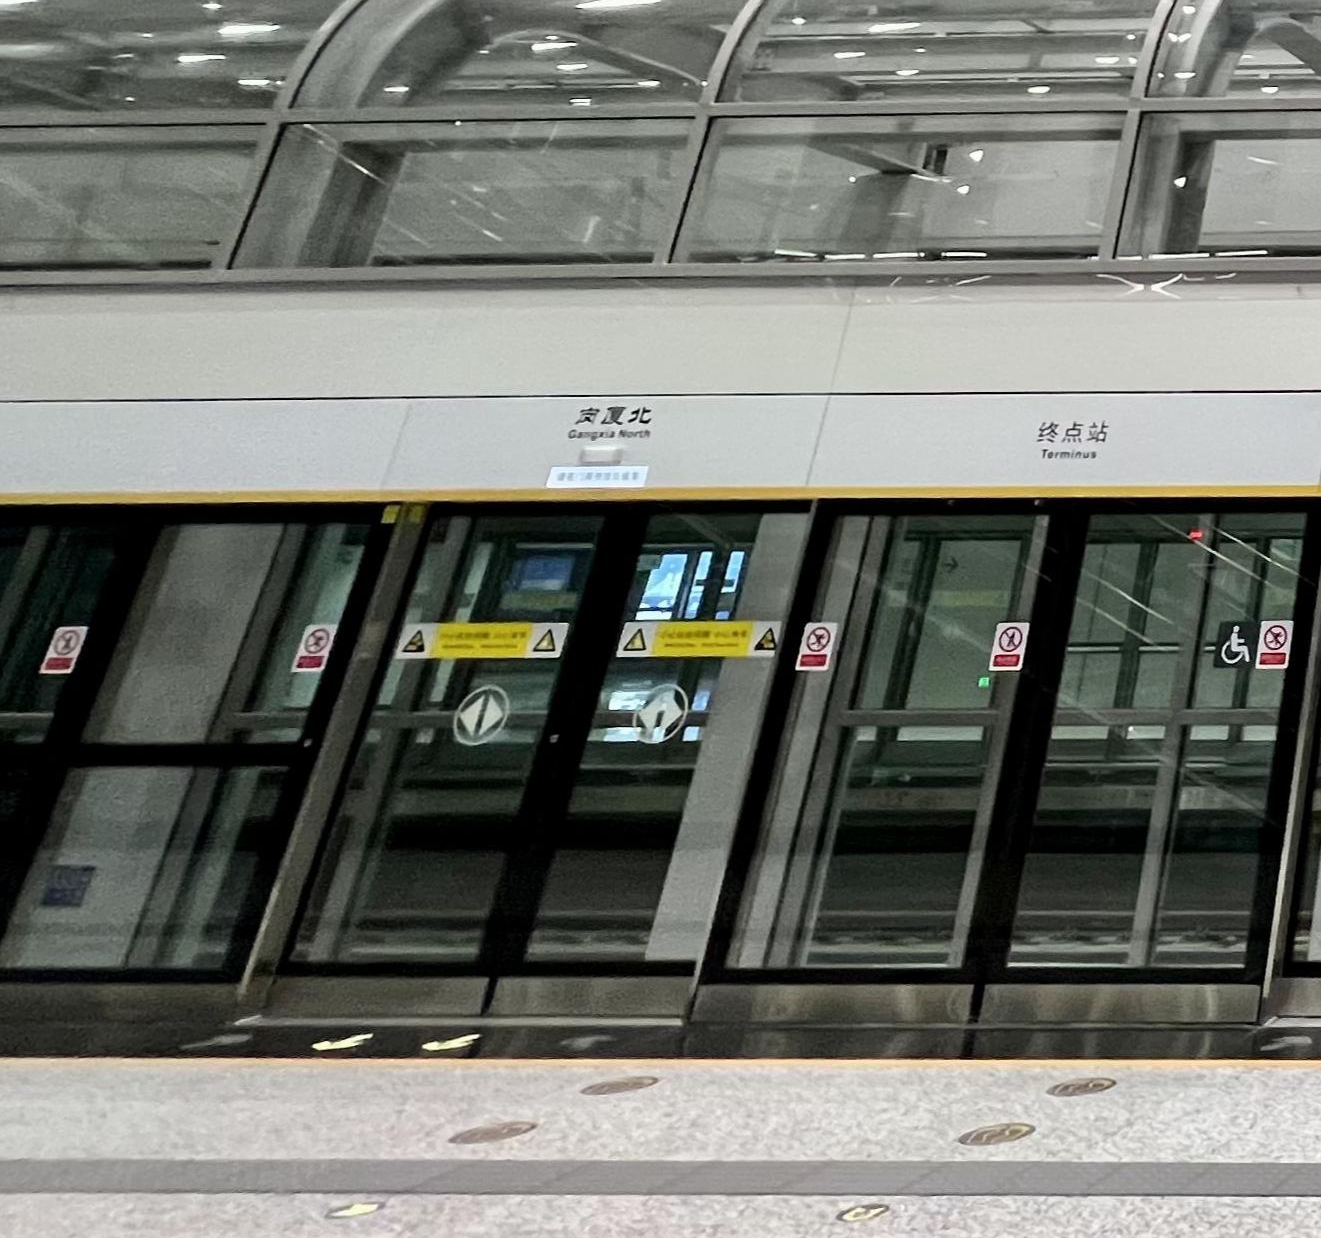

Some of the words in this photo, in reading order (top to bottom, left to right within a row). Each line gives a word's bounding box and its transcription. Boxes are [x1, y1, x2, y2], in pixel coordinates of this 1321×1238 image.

[574, 405, 652, 425] 岗厦北
[618, 429, 652, 438] North
[1036, 419, 1110, 443] 终点站
[1041, 448, 1098, 460] Terminus
